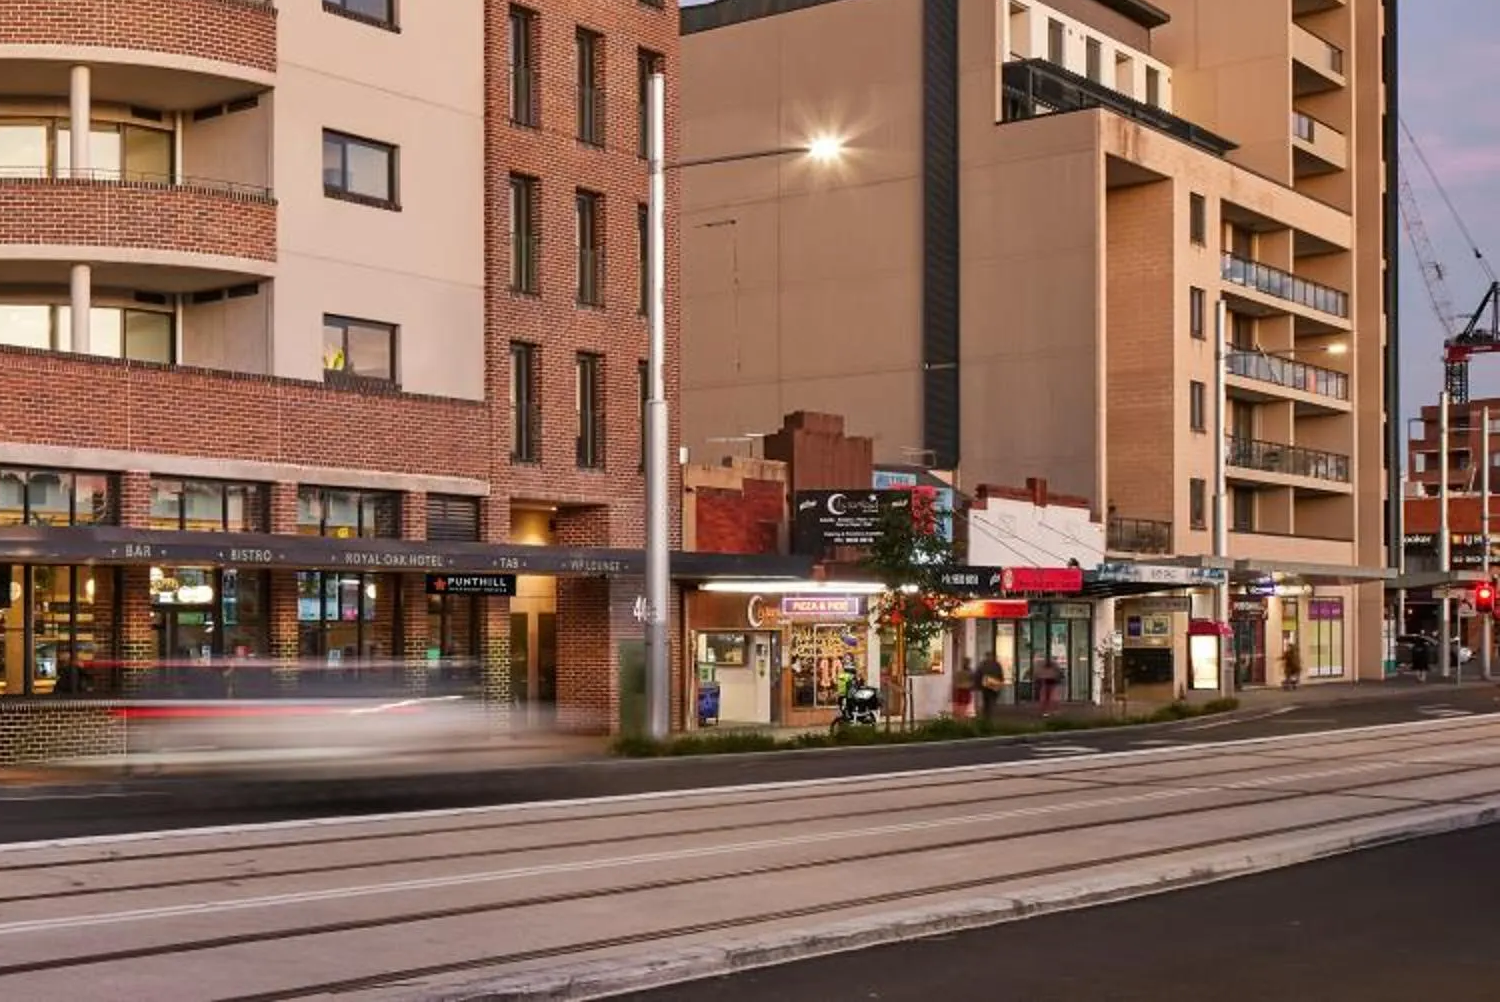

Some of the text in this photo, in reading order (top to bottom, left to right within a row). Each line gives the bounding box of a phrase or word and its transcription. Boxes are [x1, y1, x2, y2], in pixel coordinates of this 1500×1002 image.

[125, 544, 151, 558] BAR
[230, 549, 273, 562] BISTRO
[344, 552, 443, 567] ROYAL OAK HOTEL
[499, 557, 519, 569] TAB
[447, 577, 508, 587] PUNTHILL
